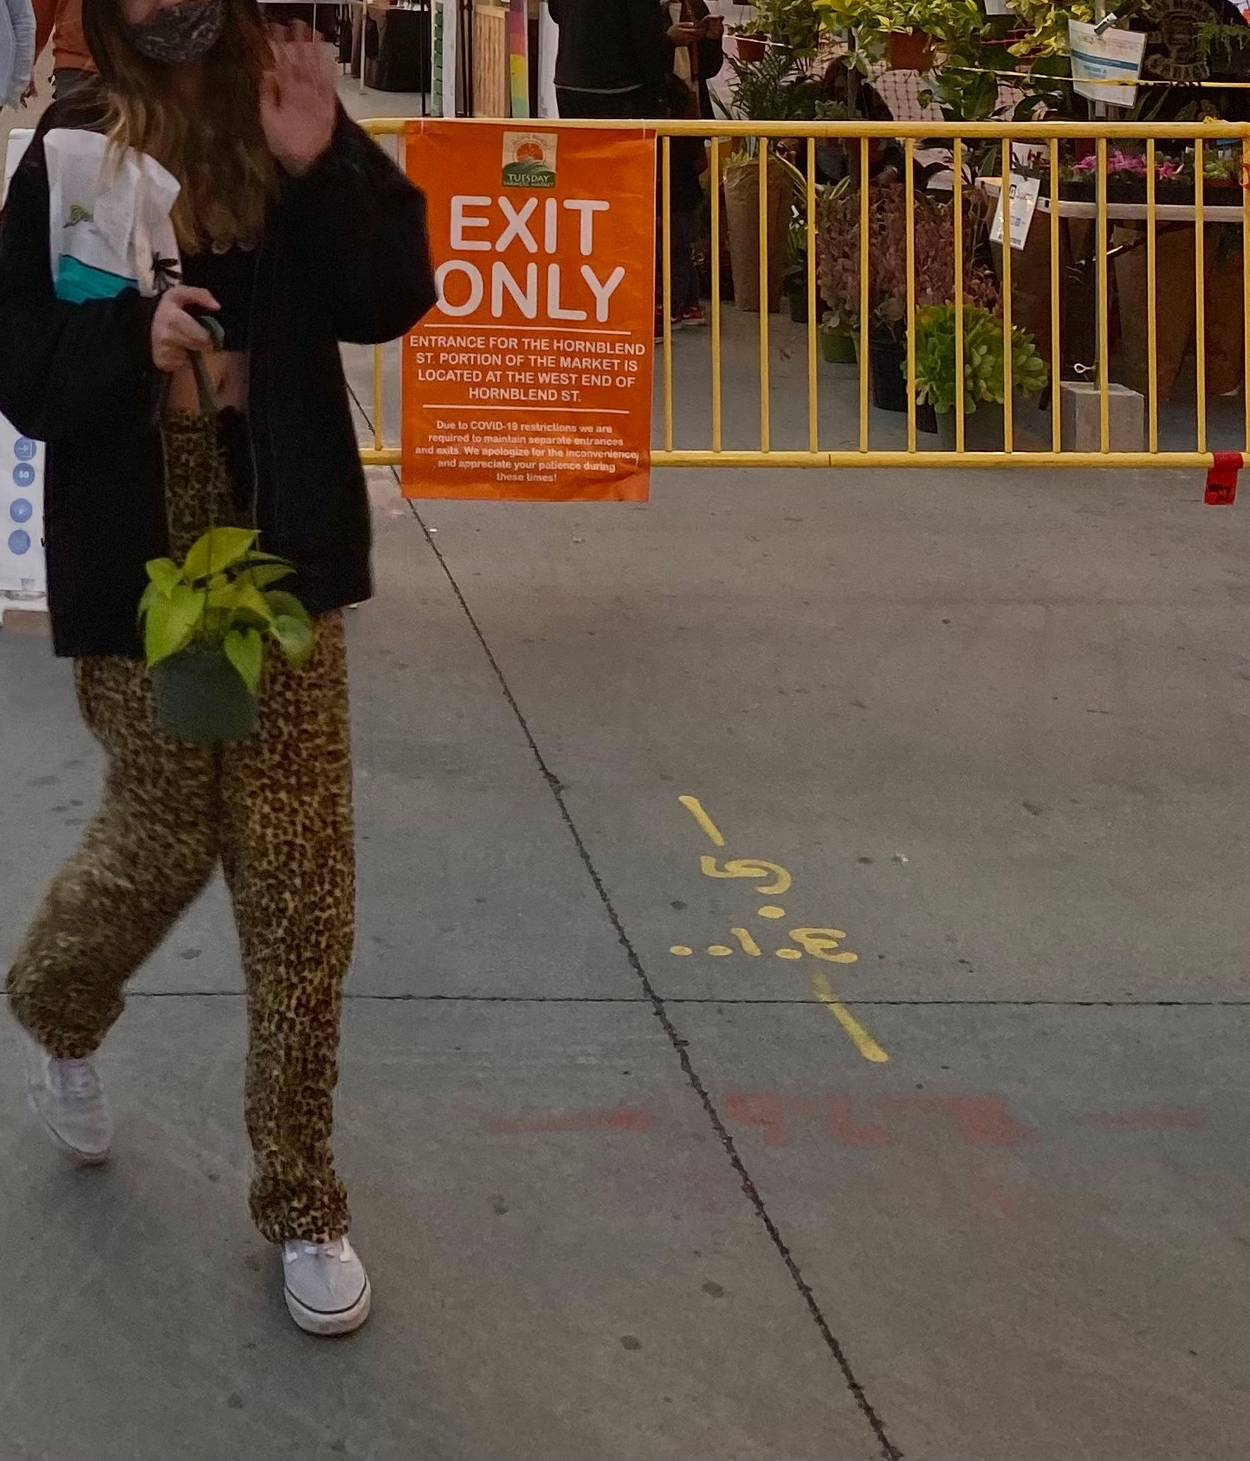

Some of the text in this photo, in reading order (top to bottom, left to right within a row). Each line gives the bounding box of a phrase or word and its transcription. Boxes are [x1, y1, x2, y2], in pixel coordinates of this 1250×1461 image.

[450, 195, 610, 256] EXIT
[435, 259, 626, 323] ONLY
[410, 335, 646, 356] ENTRANCE FOR THE HORNBLEND
[439, 353, 502, 366] PORTION
[505, 355, 525, 366] OF
[528, 356, 556, 368] THE
[560, 356, 620, 371] MARKET
[624, 360, 638, 372] IS
[418, 369, 635, 388] LOCATED AT THE WEST END OF
[468, 387, 582, 402] HORNBLEND ST.
[436, 420, 612, 434] Due to COVID-19 restrictions we are
[428, 434, 623, 447] required to maintain separate entrances
[415, 445, 434, 454] and
[463, 447, 480, 456] We
[482, 447, 530, 458] apologize
[531, 447, 545, 457] for
[548, 447, 563, 457] the
[438, 458, 616, 473] and appreciate your patience during
[496, 473, 557, 482] these times!
